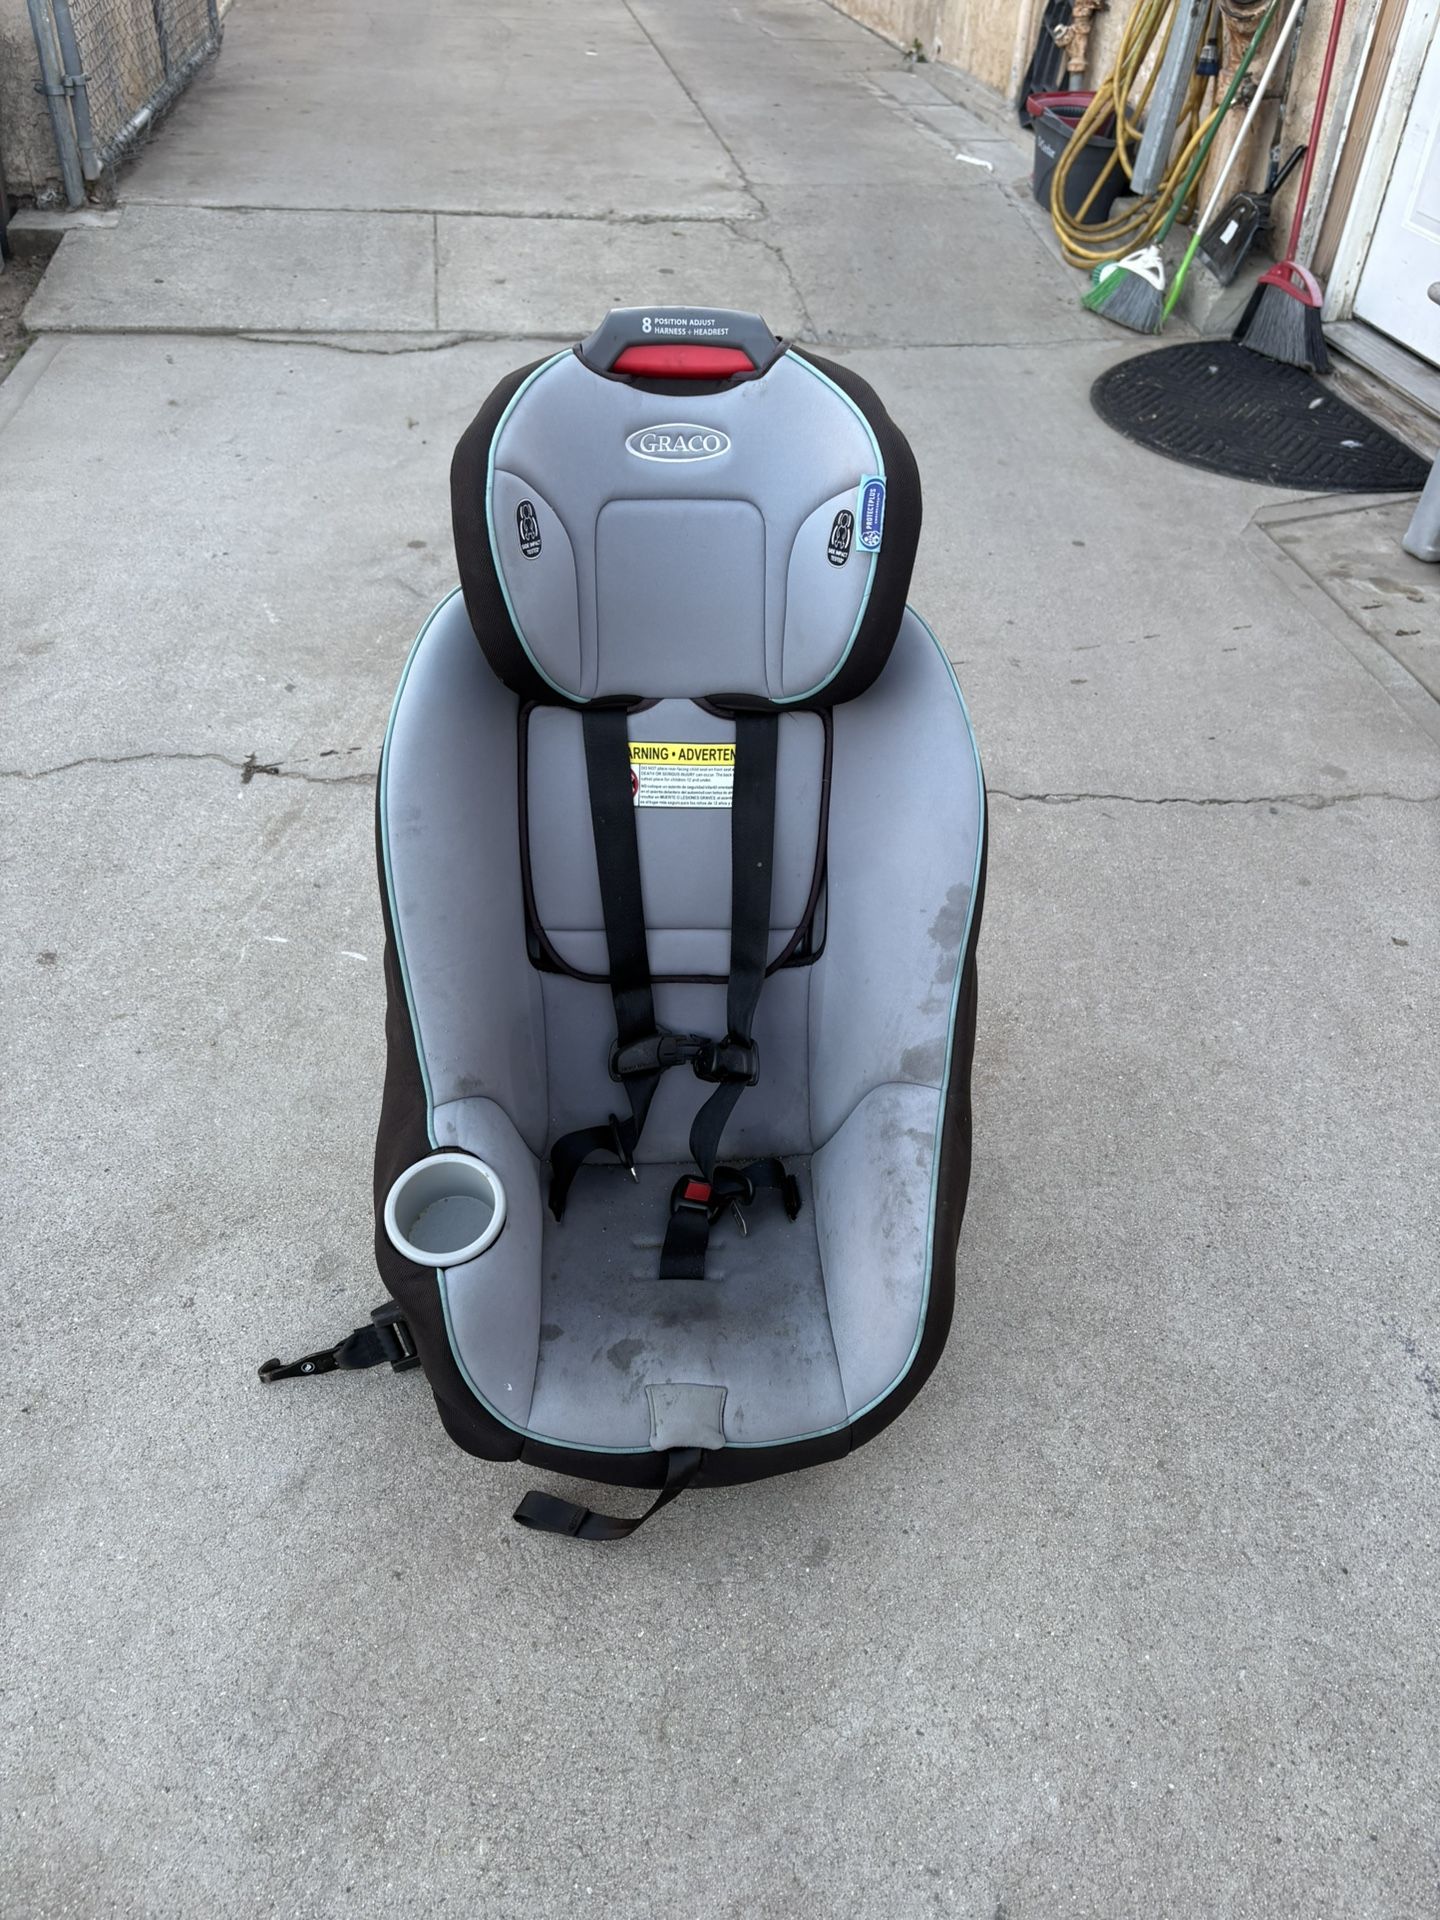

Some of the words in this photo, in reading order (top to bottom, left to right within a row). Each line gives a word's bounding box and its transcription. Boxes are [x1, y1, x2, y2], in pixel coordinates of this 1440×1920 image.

[642, 317, 652, 333] 8
[654, 318, 688, 326] POSITION
[689, 319, 716, 327] ADJUST
[654, 327, 686, 335] HARNESS
[693, 328, 729, 336] HEADREST
[640, 433, 720, 453] GRACO
[628, 747, 669, 760] ARNING
[678, 748, 736, 761] ADVERTEN
